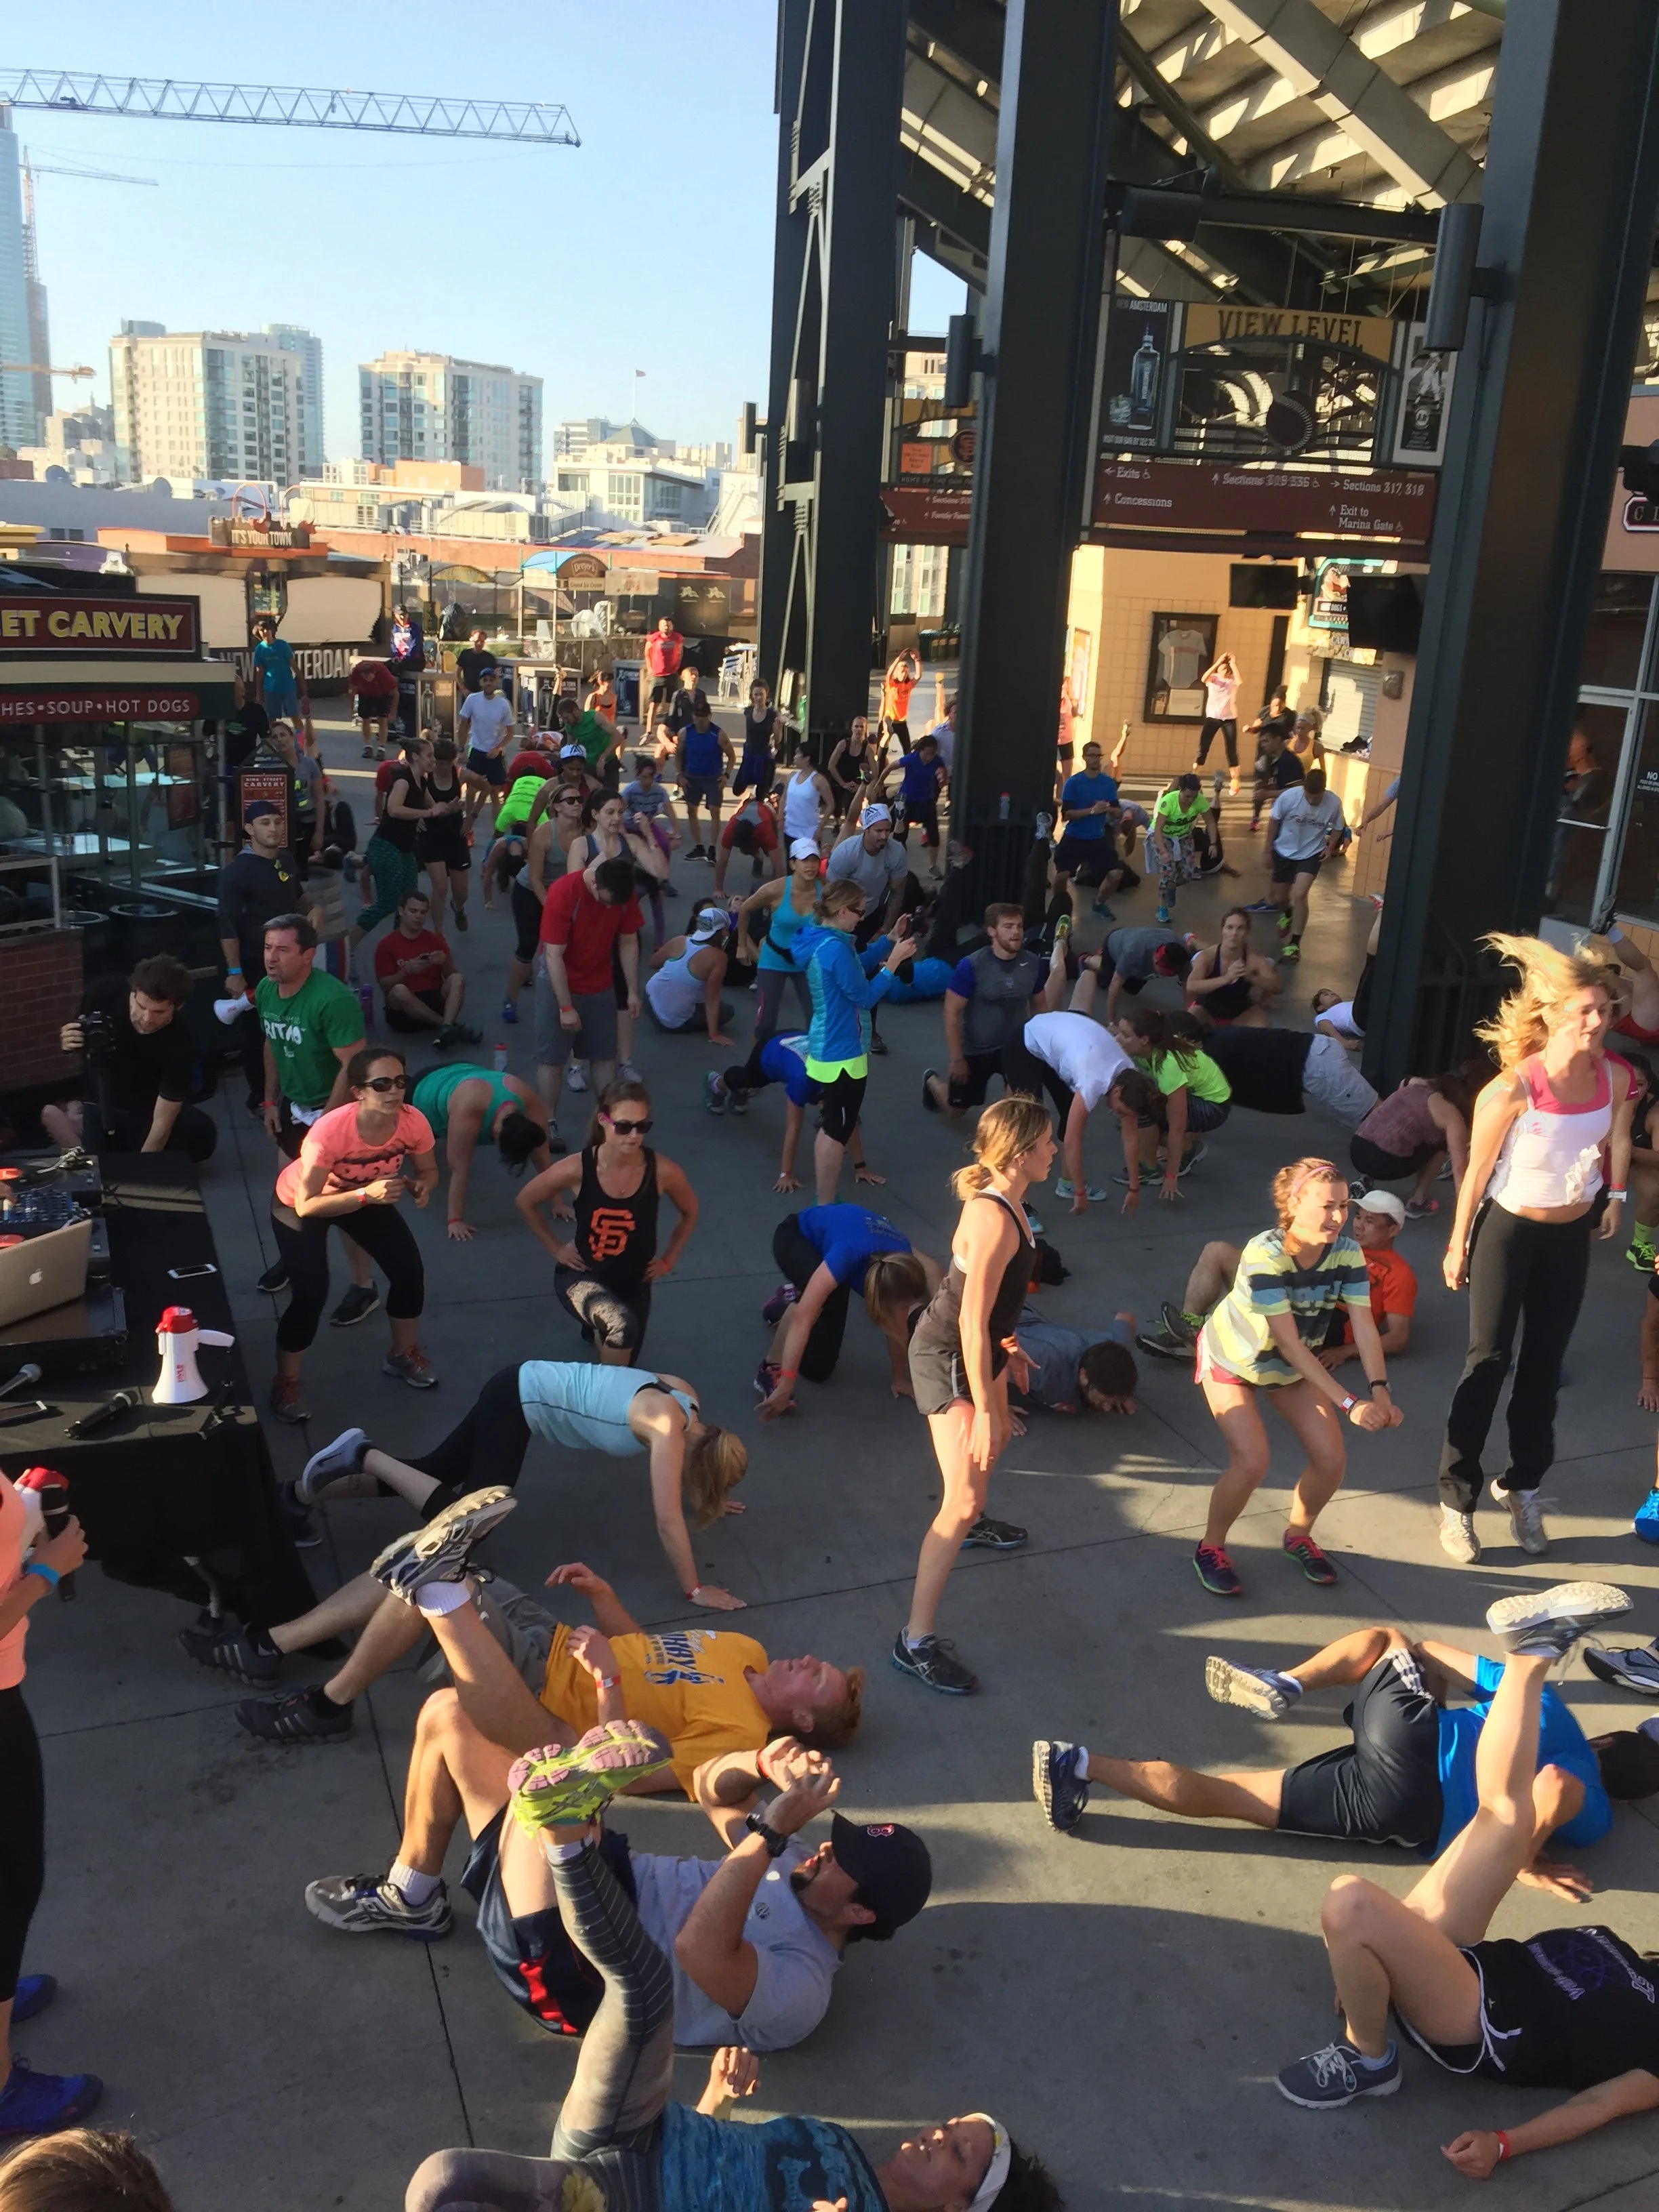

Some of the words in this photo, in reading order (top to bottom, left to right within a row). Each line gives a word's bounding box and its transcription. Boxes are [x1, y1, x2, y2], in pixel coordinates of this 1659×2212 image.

[1129, 299, 1168, 313] AMSTERDAM
[1218, 309, 1284, 339] VIEW
[1290, 314, 1363, 347] LEVEL
[1223, 472, 1265, 486] Sections
[1343, 478, 1381, 493] Sections
[1114, 493, 1173, 508] Concessions
[1340, 504, 1357, 516] Exit
[1360, 507, 1369, 516] to
[1338, 517, 1370, 530] Marina
[1374, 519, 1394, 531] Gate
[231, 529, 247, 544] IT'S
[247, 529, 269, 546] YOUR
[269, 531, 292, 546] TOWN
[573, 562, 596, 573] Dreyer's
[1, 609, 41, 637] ET
[47, 611, 184, 640] CARVERY
[1, 701, 36, 716] HES
[46, 700, 94, 715] SOUP
[105, 699, 140, 714] HOT
[147, 699, 190, 713] DOGS
[1647, 771, 1658, 781] NO
[588, 1207, 636, 1261] SF
